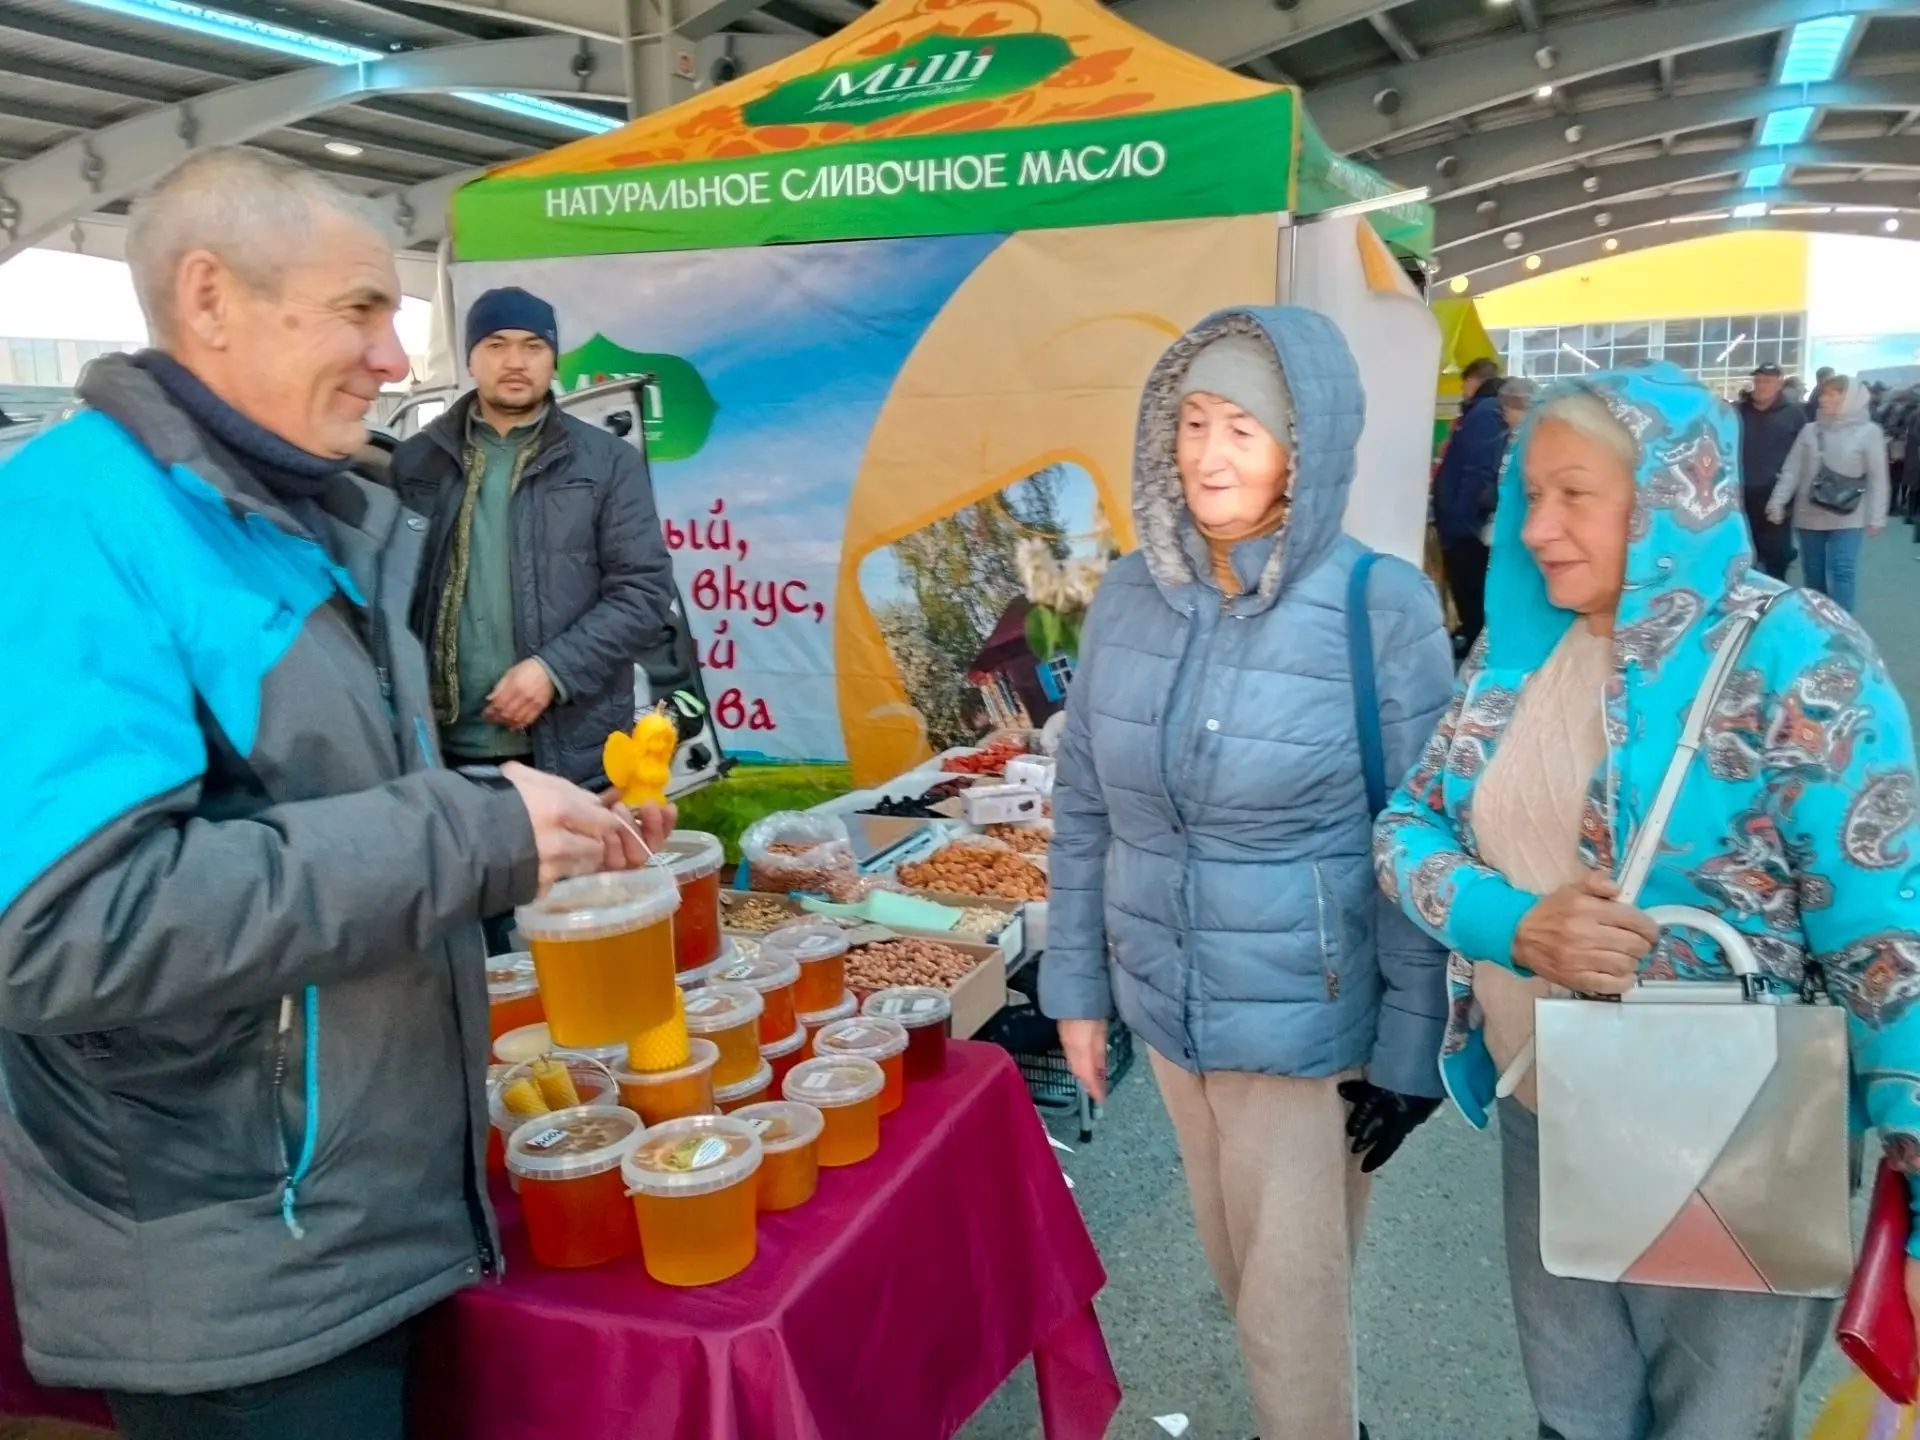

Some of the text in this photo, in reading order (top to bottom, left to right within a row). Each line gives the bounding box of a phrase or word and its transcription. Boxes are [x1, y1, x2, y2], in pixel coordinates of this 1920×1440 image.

[816, 44, 996, 102] Milli
[545, 140, 1166, 218] НАТУРАЛЬНОЕ СЛИВОЧНОЕ МАСЛО
[663, 498, 748, 561] ый,
[691, 564, 825, 627] вкус,
[715, 687, 777, 731] ва
